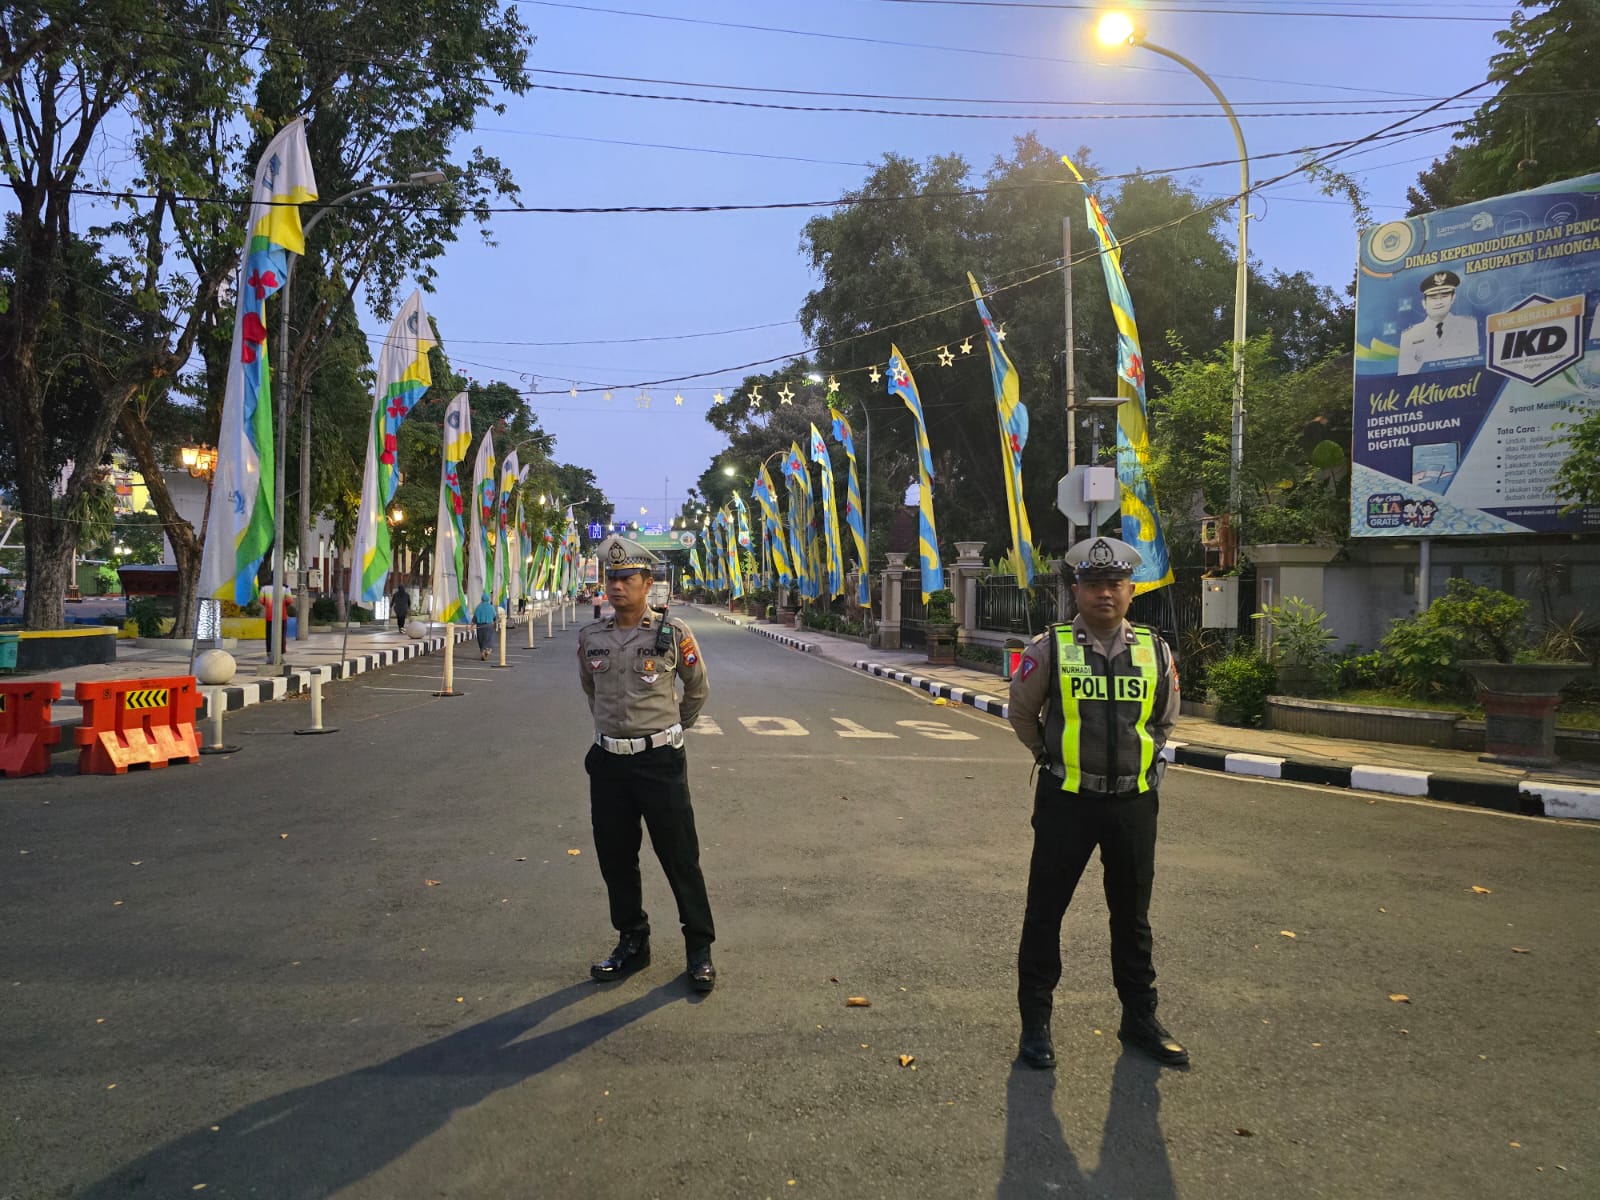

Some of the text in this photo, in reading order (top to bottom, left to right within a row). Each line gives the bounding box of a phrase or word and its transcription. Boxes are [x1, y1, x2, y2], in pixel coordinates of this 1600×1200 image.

[1405, 251, 1439, 269] DINAS
[1440, 232, 1533, 262] KEPENDUDUKAN
[1535, 223, 1563, 242] DAN
[1565, 218, 1600, 237] PENC
[1465, 251, 1534, 274] KABUPATEN
[1501, 325, 1568, 360] IKD
[1369, 371, 1482, 415] Yuk Aktivasi!
[1509, 404, 1535, 414] Syarat
[1367, 410, 1424, 428] IDENTITAS
[1367, 417, 1461, 440] KEPENDUDUKAN
[1497, 427, 1514, 435] Tata
[1516, 425, 1536, 434] Cara
[1367, 437, 1412, 452] DIGITAL
[1369, 502, 1402, 514] KIA
[1370, 518, 1400, 526] GRATIS
[1061, 665, 1092, 674] NURHADI
